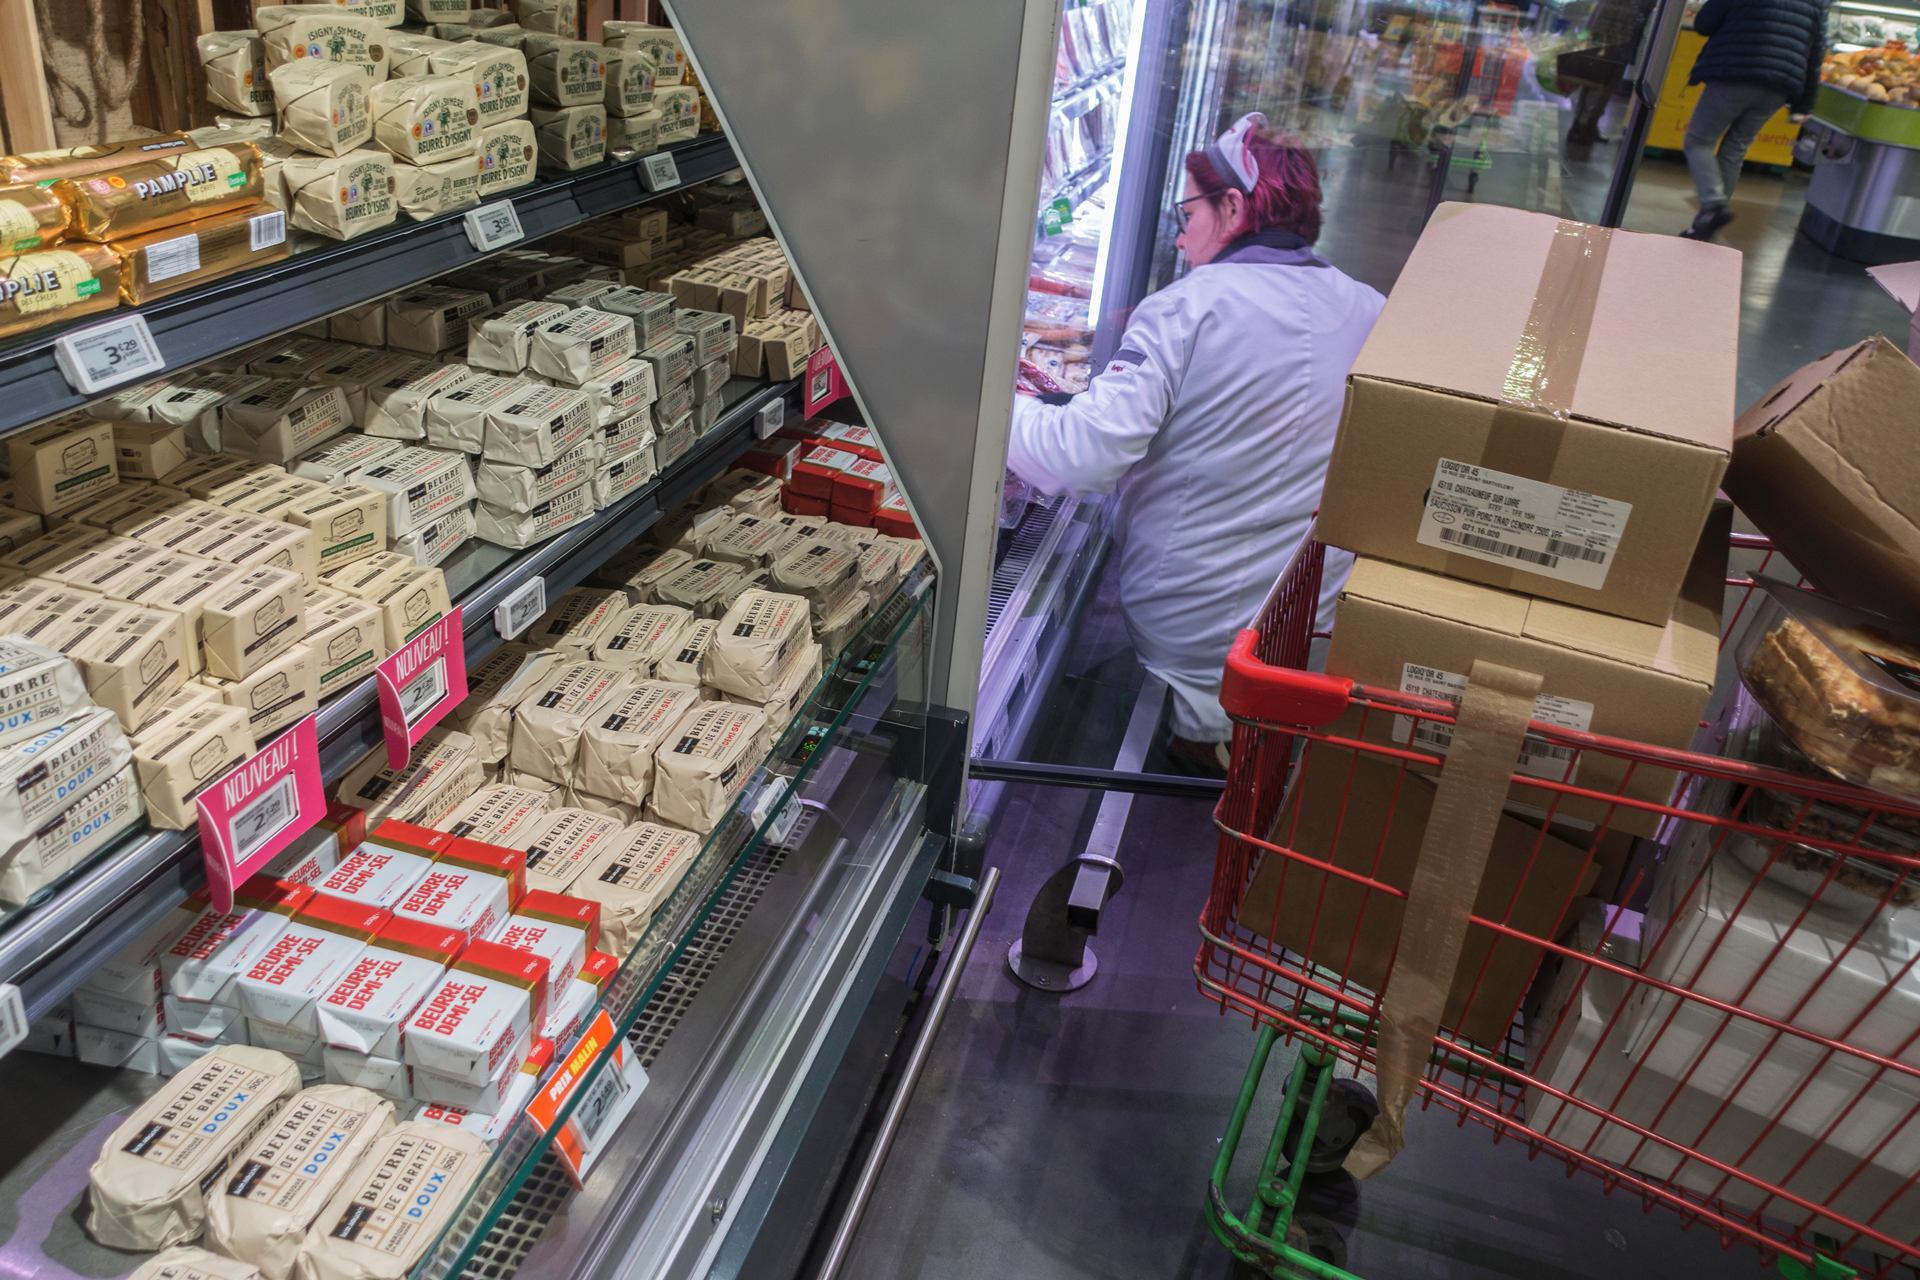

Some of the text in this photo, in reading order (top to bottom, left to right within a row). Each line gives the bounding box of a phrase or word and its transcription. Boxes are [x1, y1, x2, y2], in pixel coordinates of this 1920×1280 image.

[418, 127, 473, 155] BEURRE D'ISIGNY
[135, 163, 218, 200] PAMPLIE
[480, 162, 529, 186] BEURRE D'ISIGNY
[344, 203, 367, 222] BEURRE
[305, 390, 337, 415] BEURRE
[563, 399, 589, 421] BEURRE
[427, 467, 460, 491] BEURRE
[1471, 467, 1480, 477] 45
[550, 488, 583, 510] BEURRE
[1454, 483, 1493, 501] CHATEAUNEUF
[1492, 493, 1504, 504] SUR
[1504, 495, 1521, 509] LOIRE
[1430, 498, 1462, 514] SAUCISSON
[1462, 507, 1475, 518] PUR
[1475, 509, 1493, 523] PORC
[1493, 514, 1510, 527] TRAD
[1509, 517, 1534, 534] CENDRE
[619, 610, 645, 638] BEURRE
[743, 597, 767, 624] BEURRE
[395, 622, 443, 682] NOUVEAU
[444, 618, 451, 647] !
[687, 623, 713, 651] BEURRE
[554, 665, 587, 693] BEURRE
[1435, 671, 1445, 681] 45
[618, 686, 650, 717] BEURRE
[650, 697, 674, 722] DEMI-SEL
[22, 726, 69, 754] DOUX
[689, 708, 718, 738] BEURRE
[721, 720, 744, 748] DEMI-SEL
[50, 728, 106, 771] BEURRE
[56, 764, 95, 800] DOUX
[223, 730, 300, 812] NOUVEAU !
[467, 787, 511, 824] BEURRE
[483, 790, 526, 830] DE BARATTE
[497, 804, 530, 835] DEMI-SEL
[72, 810, 112, 844] DOUX
[539, 811, 582, 849] BEURRE
[557, 814, 596, 857] DE BARATTE
[570, 830, 602, 862] DEMI-SEL
[619, 827, 658, 866] BEURRE
[635, 830, 673, 870] DE BARATTE
[653, 842, 682, 875] DEMI-SEL
[322, 850, 374, 891] BEURRE
[341, 853, 395, 895] DEMI-SEL
[400, 871, 449, 913] BEURRE
[420, 873, 469, 917] DEMI-SEL
[169, 911, 221, 958] BEURRE
[190, 912, 248, 961] DEMI-SEL
[245, 933, 304, 981] BEURRE
[266, 936, 326, 986] DEMI-SEL
[325, 956, 381, 1007] BEURRE
[346, 959, 404, 1011] DEMI-SEL
[414, 980, 466, 1030] BEURRE
[434, 984, 488, 1036] DEMI-SEL
[548, 1036, 600, 1102] PRIX MALIN
[161, 1062, 228, 1122] BEURRE
[180, 1066, 247, 1130] DE BARATTE
[202, 1091, 250, 1135] DOUX
[258, 1100, 318, 1161] BEURRE
[279, 1106, 338, 1170] DE BARATTE
[302, 1130, 347, 1175] DOUX
[361, 1139, 416, 1203] BEURRE
[383, 1141, 438, 1212] DE BARATTE
[406, 1171, 447, 1219] DOUX
